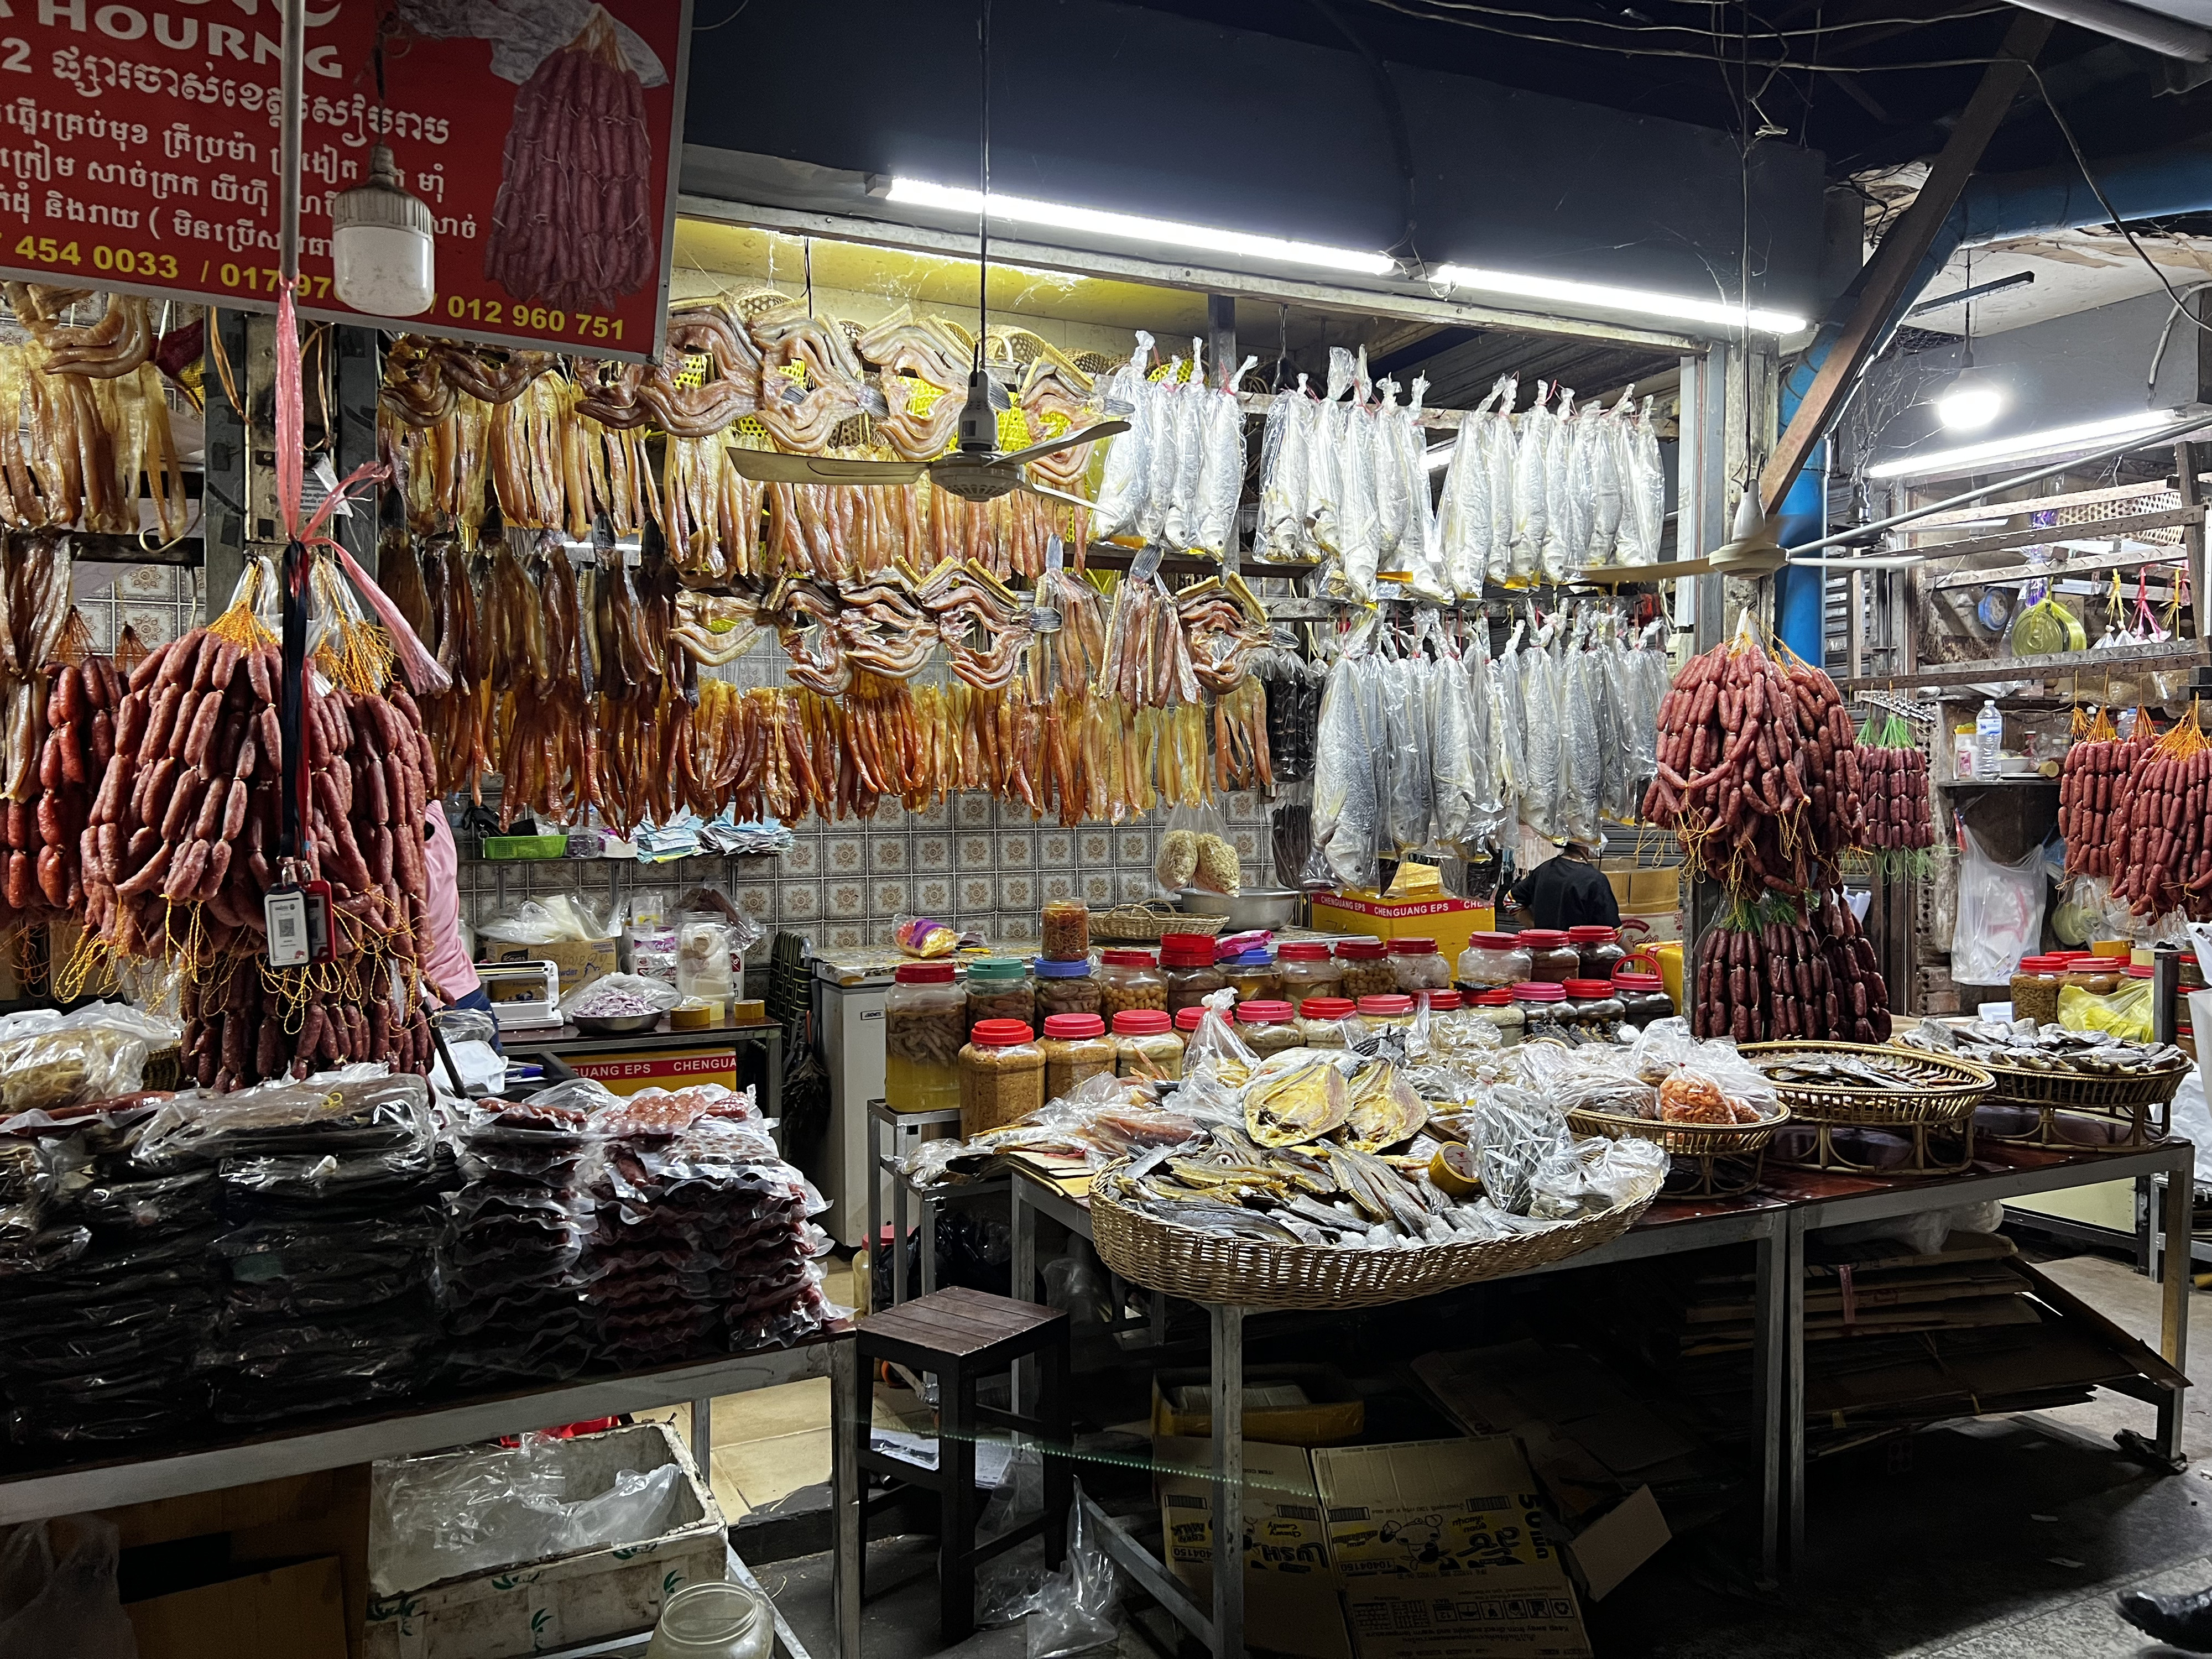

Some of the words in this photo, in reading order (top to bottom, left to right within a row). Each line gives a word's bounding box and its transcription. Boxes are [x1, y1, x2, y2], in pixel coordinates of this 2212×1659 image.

[2, 37, 32, 73] 2
[15, 235, 81, 265] 454
[93, 245, 179, 279] 0033
[220, 263, 280, 293] 017
[297, 274, 343, 301] 97
[448, 295, 502, 324] 012
[512, 304, 565, 332] 960
[576, 314, 624, 341] 751
[1321, 896, 1353, 910] CHENGUANG
[1354, 902, 1365, 912] EPS
[1374, 906, 1427, 917] CHENGUANG
[1430, 902, 1448, 912] EPS
[625, 1063, 651, 1074] EPS
[674, 1057, 736, 1072] CHENGUA
[1171, 1524, 1204, 1536] MILK
[1267, 1522, 1297, 1531] Candy
[1269, 1529, 1302, 1538] Chewy
